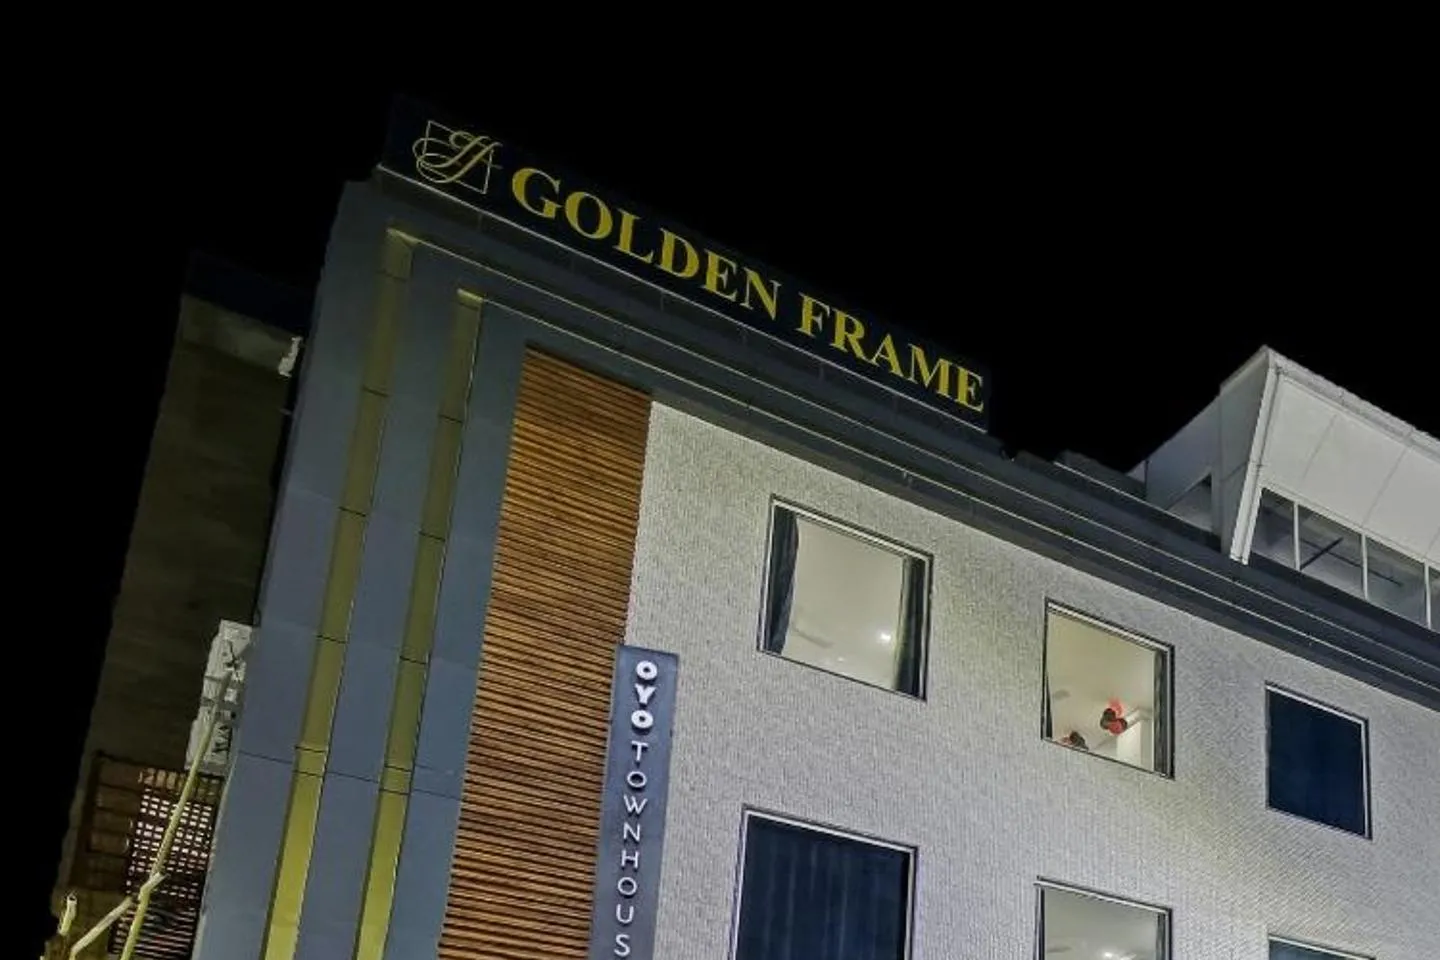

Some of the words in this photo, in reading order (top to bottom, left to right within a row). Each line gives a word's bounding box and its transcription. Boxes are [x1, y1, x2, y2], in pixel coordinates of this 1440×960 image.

[511, 166, 782, 320] GOLDEN
[796, 292, 985, 413] FRAME
[630, 659, 659, 730] OYO
